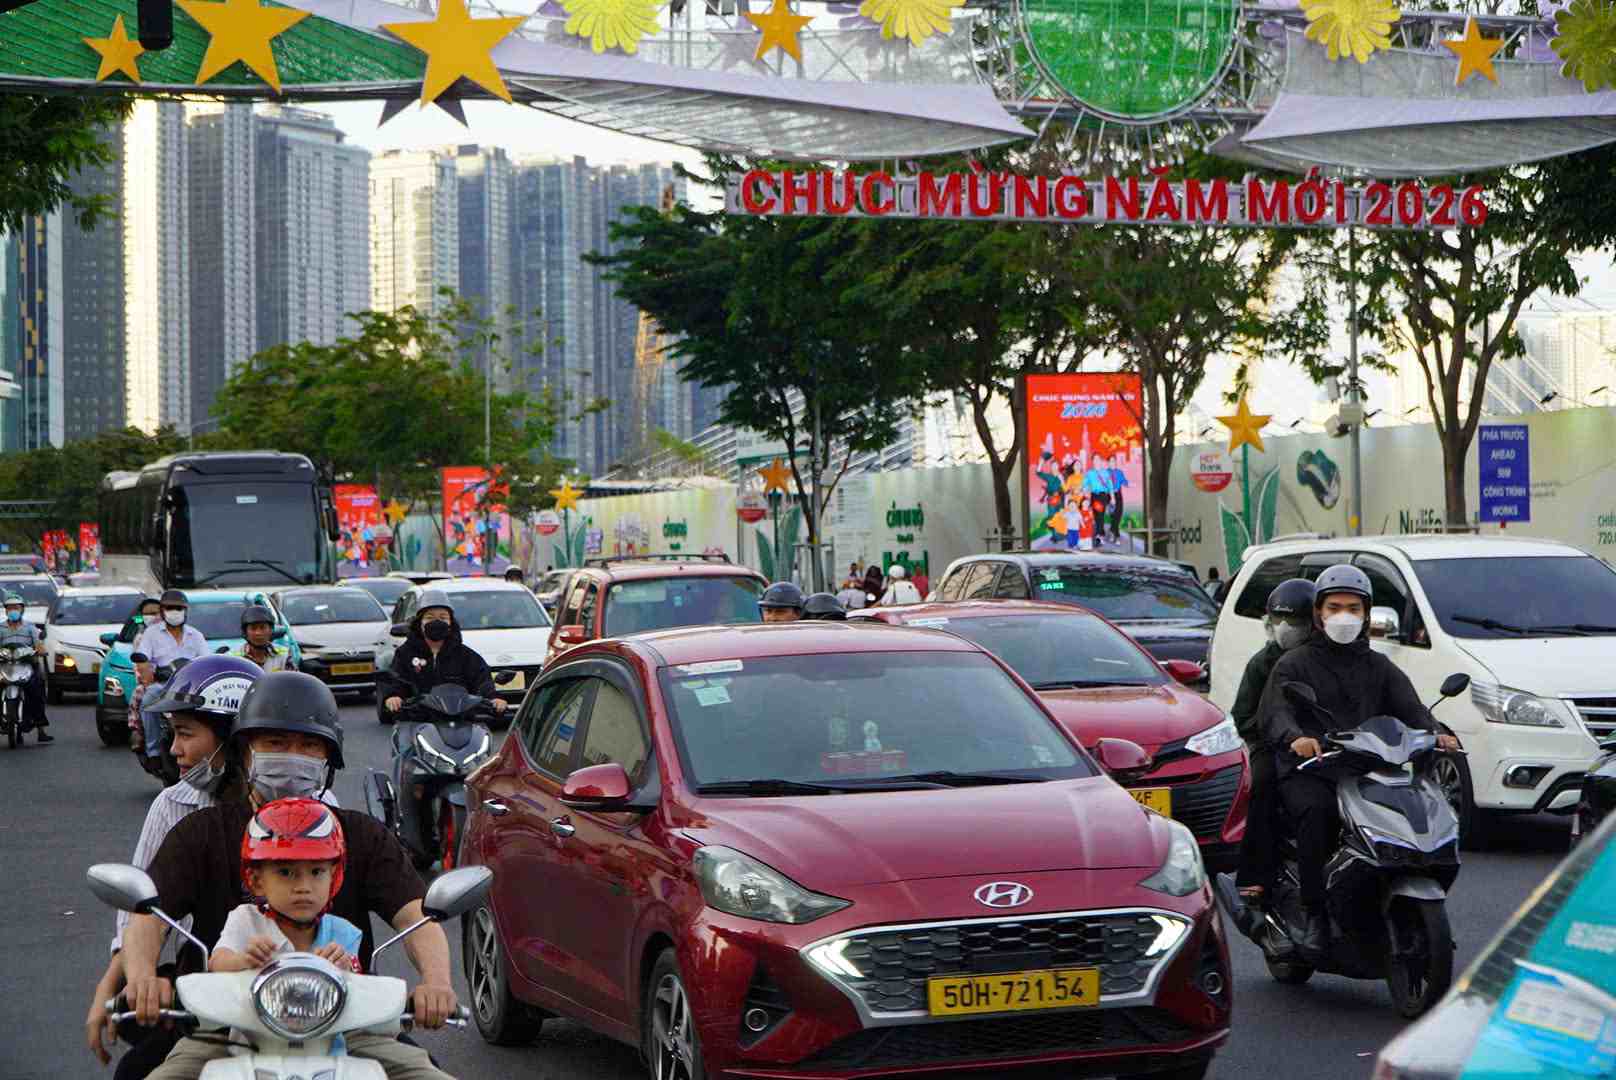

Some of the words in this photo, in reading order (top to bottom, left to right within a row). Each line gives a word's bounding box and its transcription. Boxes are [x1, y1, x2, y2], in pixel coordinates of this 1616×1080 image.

[918, 160, 1088, 219] MỪNG
[1105, 165, 1229, 224] NĂM
[1247, 165, 1347, 226] MỚI
[1365, 180, 1489, 228] 2026
[1491, 449, 1516, 460] AHEAD
[1492, 504, 1518, 516] WORKS
[943, 976, 1085, 1009] 50H-721.54
